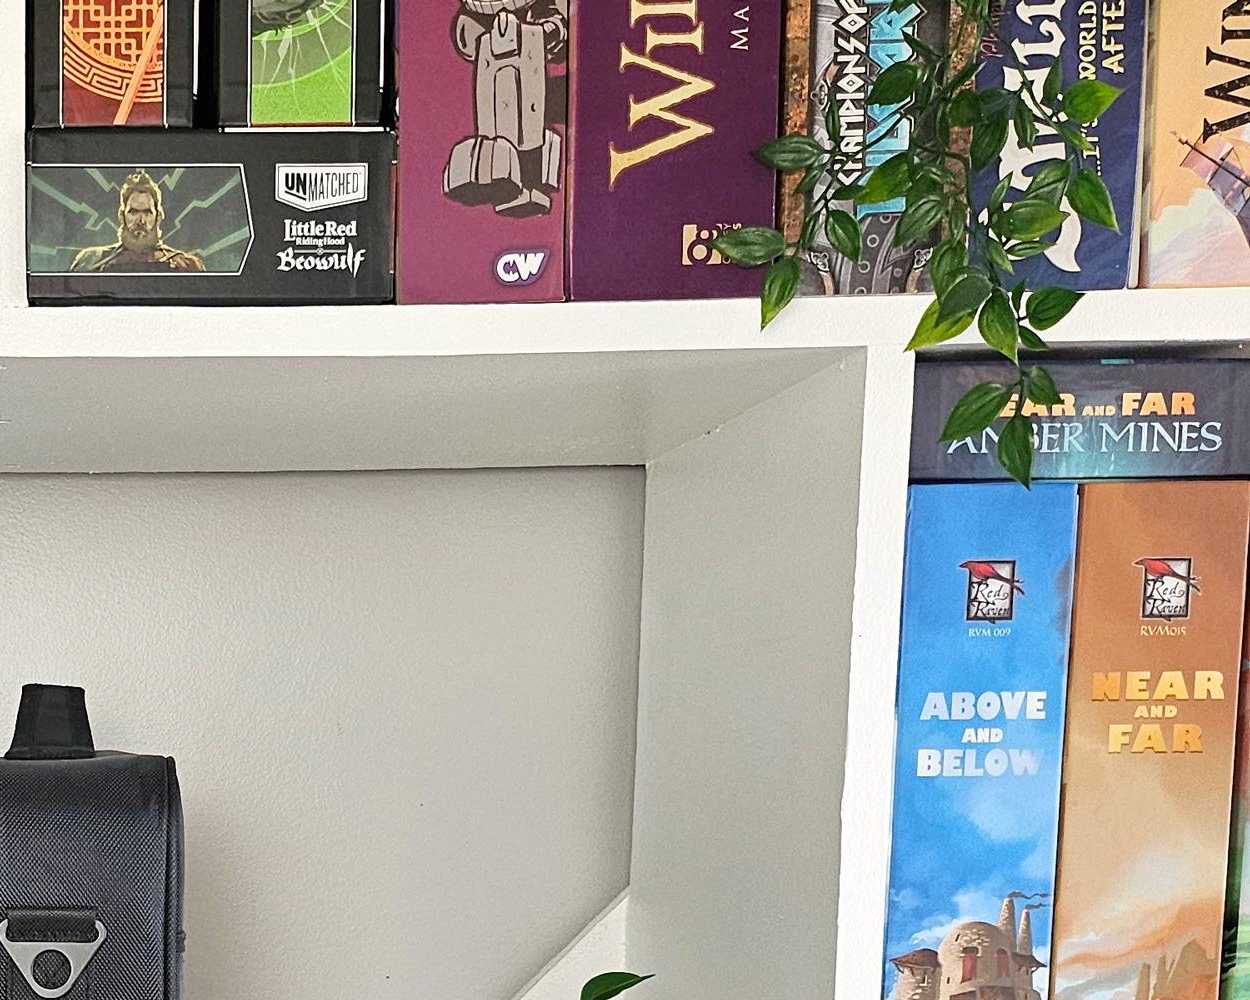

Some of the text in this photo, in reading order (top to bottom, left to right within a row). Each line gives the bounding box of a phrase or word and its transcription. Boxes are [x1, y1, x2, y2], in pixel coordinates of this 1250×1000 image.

[284, 172, 359, 202] UNMATCHED
[284, 219, 357, 242] Little Red
[296, 237, 345, 246] Riding Hood
[278, 243, 366, 278] Beowulf
[1082, 392, 1196, 416] AND FAR
[1101, 422, 1222, 453] MINES
[971, 580, 1010, 602] Red
[1146, 580, 1187, 601] Red
[970, 599, 1011, 621] Raven
[1146, 598, 1187, 619] Raven
[993, 628, 1011, 636] 009
[1091, 670, 1225, 702] NEAR
[919, 691, 1047, 721] ABOVE
[1134, 705, 1178, 719] AND
[961, 728, 1003, 743] AND
[1108, 724, 1204, 754] FAR
[917, 749, 1041, 777] BELOW
